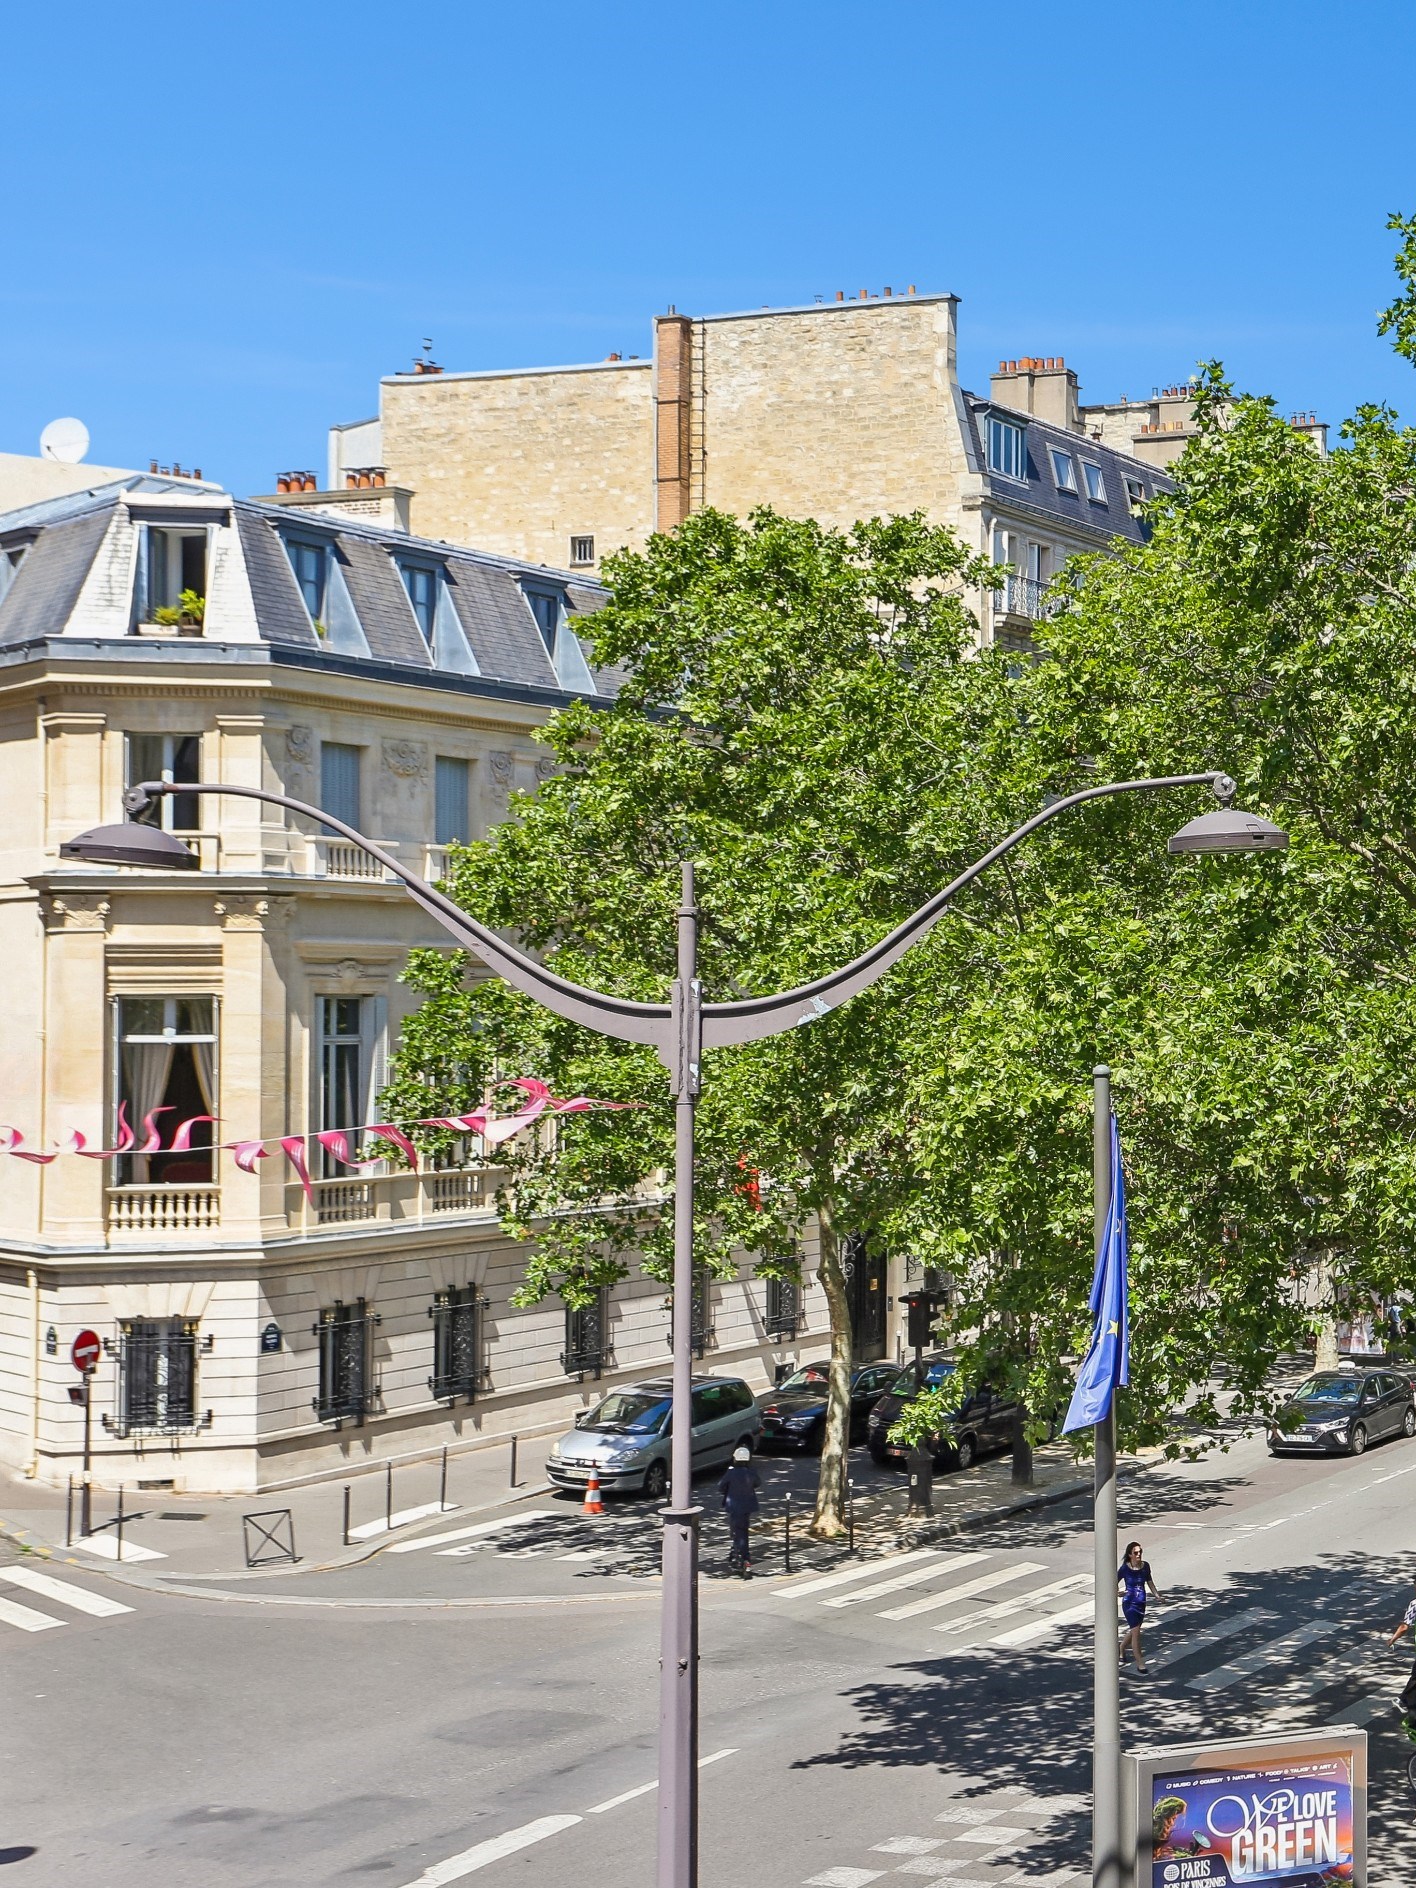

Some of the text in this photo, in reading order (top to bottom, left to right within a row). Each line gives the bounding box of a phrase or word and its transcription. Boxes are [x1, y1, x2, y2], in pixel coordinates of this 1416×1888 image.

[1199, 1777, 1224, 1785] COMEDY
[1232, 1773, 1256, 1781] NATURE
[1293, 1790, 1337, 1820] LOVE
[1231, 1817, 1337, 1876] GREEN
[1181, 1860, 1211, 1880] PARIS
[1191, 1876, 1227, 1888] VINCENNES
